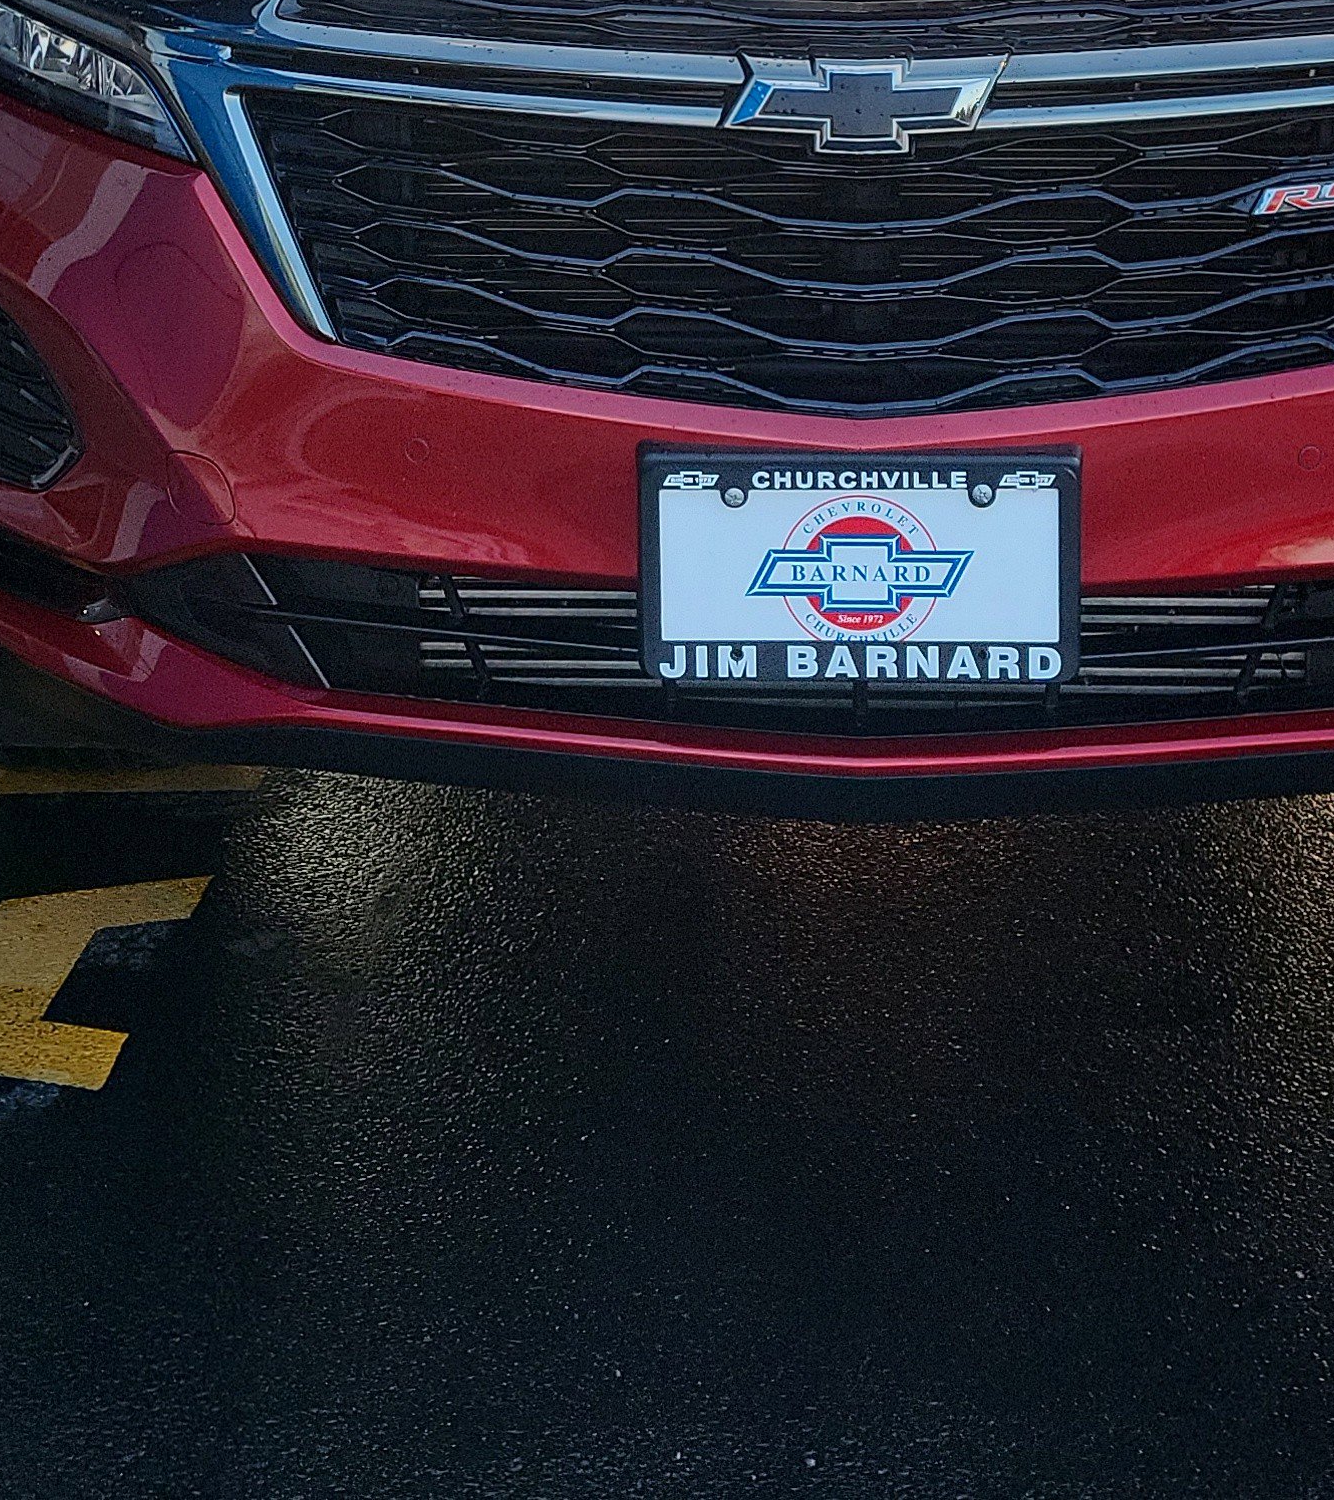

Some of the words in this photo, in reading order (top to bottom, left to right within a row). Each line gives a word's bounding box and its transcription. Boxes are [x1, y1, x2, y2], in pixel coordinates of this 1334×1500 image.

[751, 471, 968, 490] CHURCHVILLE
[803, 501, 919, 535] CHEVROLET
[791, 564, 931, 582] BARNARD
[837, 614, 862, 624] Since
[863, 614, 884, 624] 1972
[658, 645, 758, 680] JIM
[787, 644, 1063, 681] BARNARD
